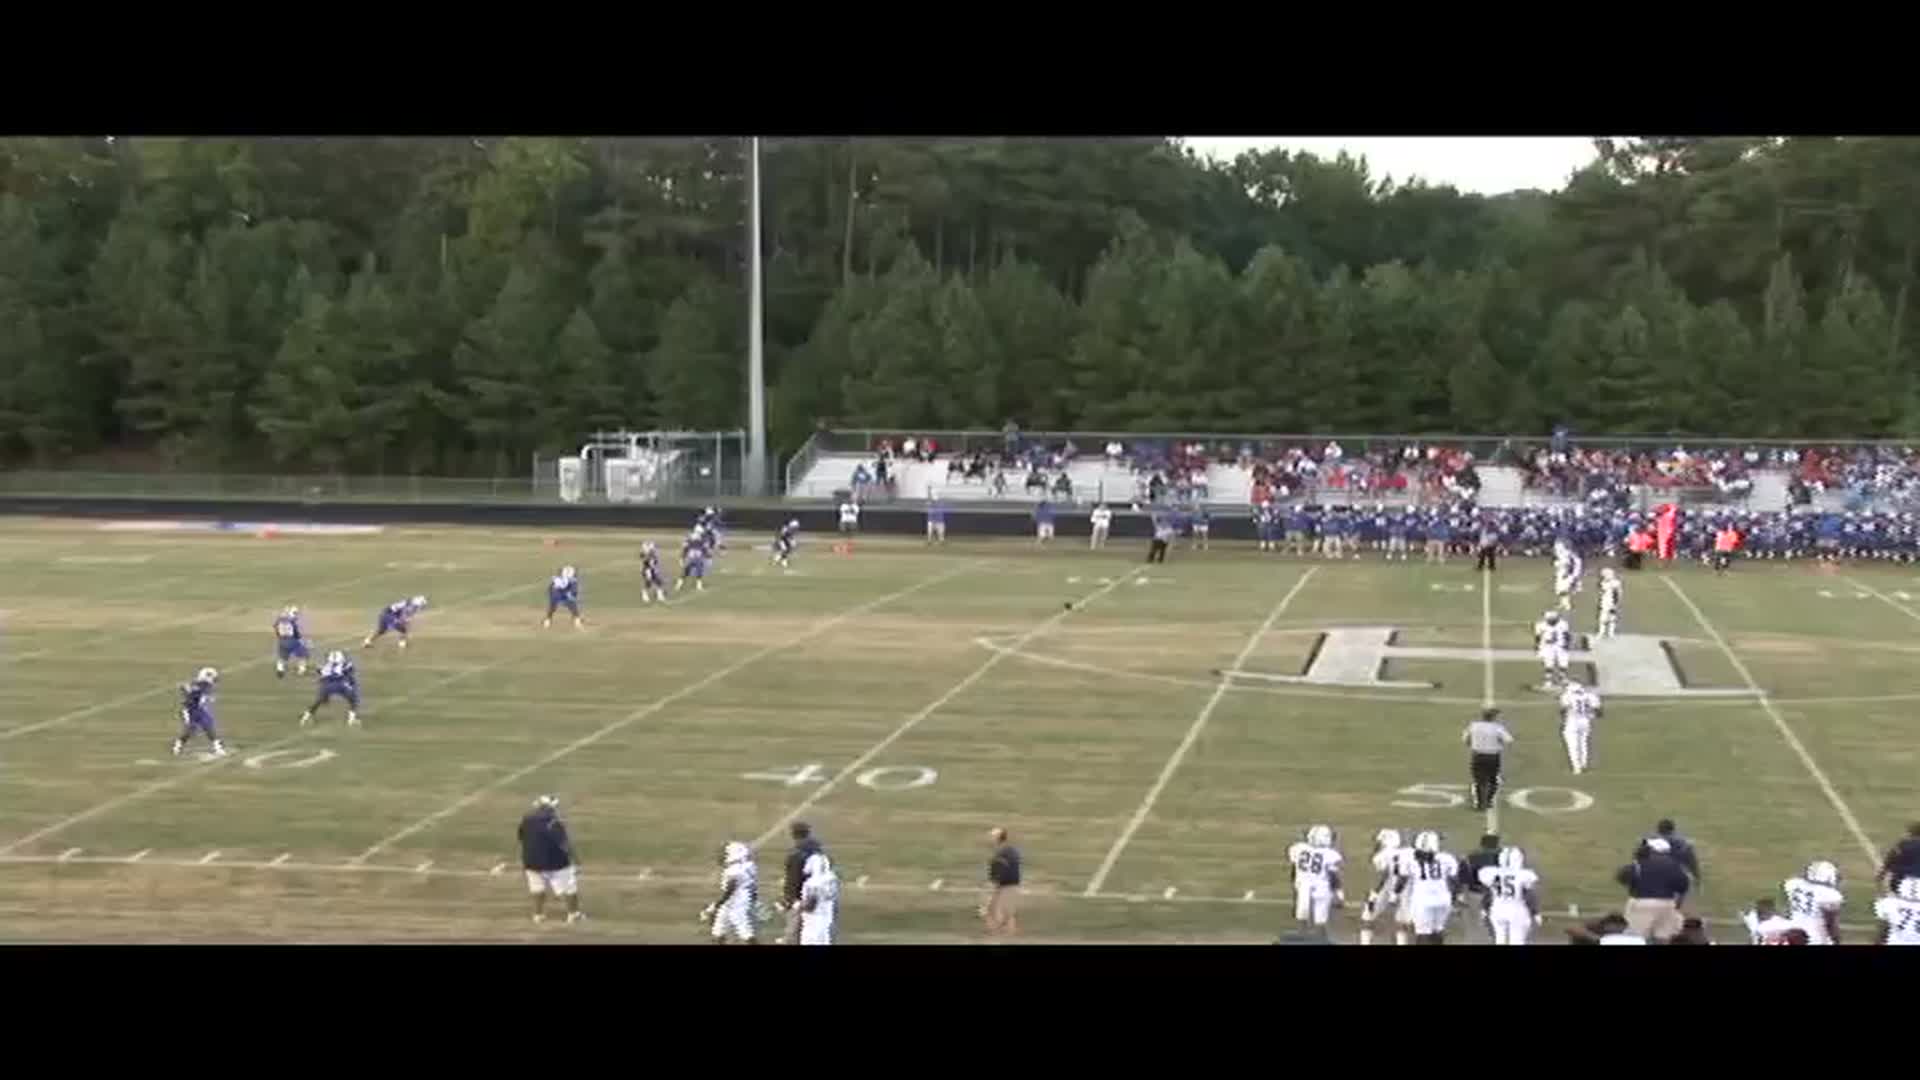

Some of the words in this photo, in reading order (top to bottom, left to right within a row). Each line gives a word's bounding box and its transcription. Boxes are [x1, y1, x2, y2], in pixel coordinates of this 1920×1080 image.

[1213, 627, 1763, 695] H
[743, 764, 937, 790] 40
[1391, 783, 1594, 813] 50
[1299, 851, 1323, 875] 28
[1492, 875, 1516, 898] 45
